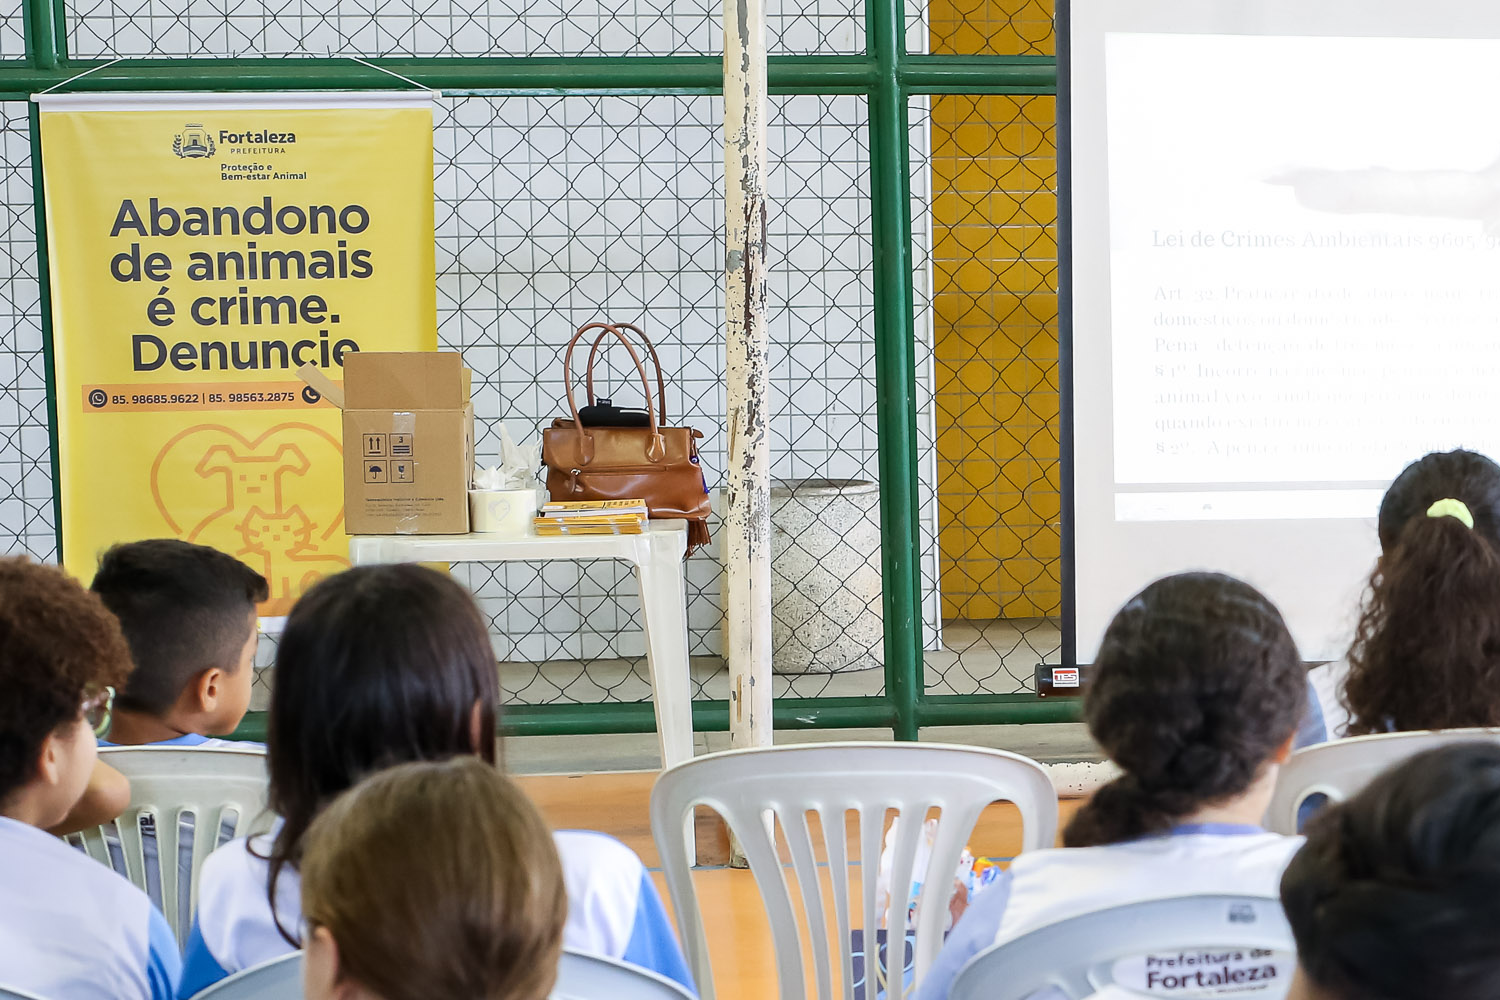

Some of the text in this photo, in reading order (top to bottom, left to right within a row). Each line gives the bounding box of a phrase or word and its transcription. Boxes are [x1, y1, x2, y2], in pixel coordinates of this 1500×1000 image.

[219, 129, 296, 144] Fortaleza
[230, 147, 286, 155] PREFEITURA
[220, 163, 265, 173] Proteção
[221, 171, 307, 181] Bem-estar Animal
[110, 196, 370, 238] Abandono
[1151, 230, 1185, 248] Lei
[1190, 230, 1216, 248] de
[1220, 229, 1296, 248] Crimes
[1301, 230, 1424, 248] Ambientais
[110, 240, 374, 282] de animais
[147, 285, 341, 327] é crime.
[131, 330, 361, 372] Denuncie
[112, 394, 129, 405] 85.
[132, 393, 199, 404] 98685.9622
[208, 392, 226, 403] 85.
[228, 391, 295, 403] 98563.2875
[1145, 951, 1243, 968] Prefeitura
[1146, 962, 1278, 989] Fortaleza
